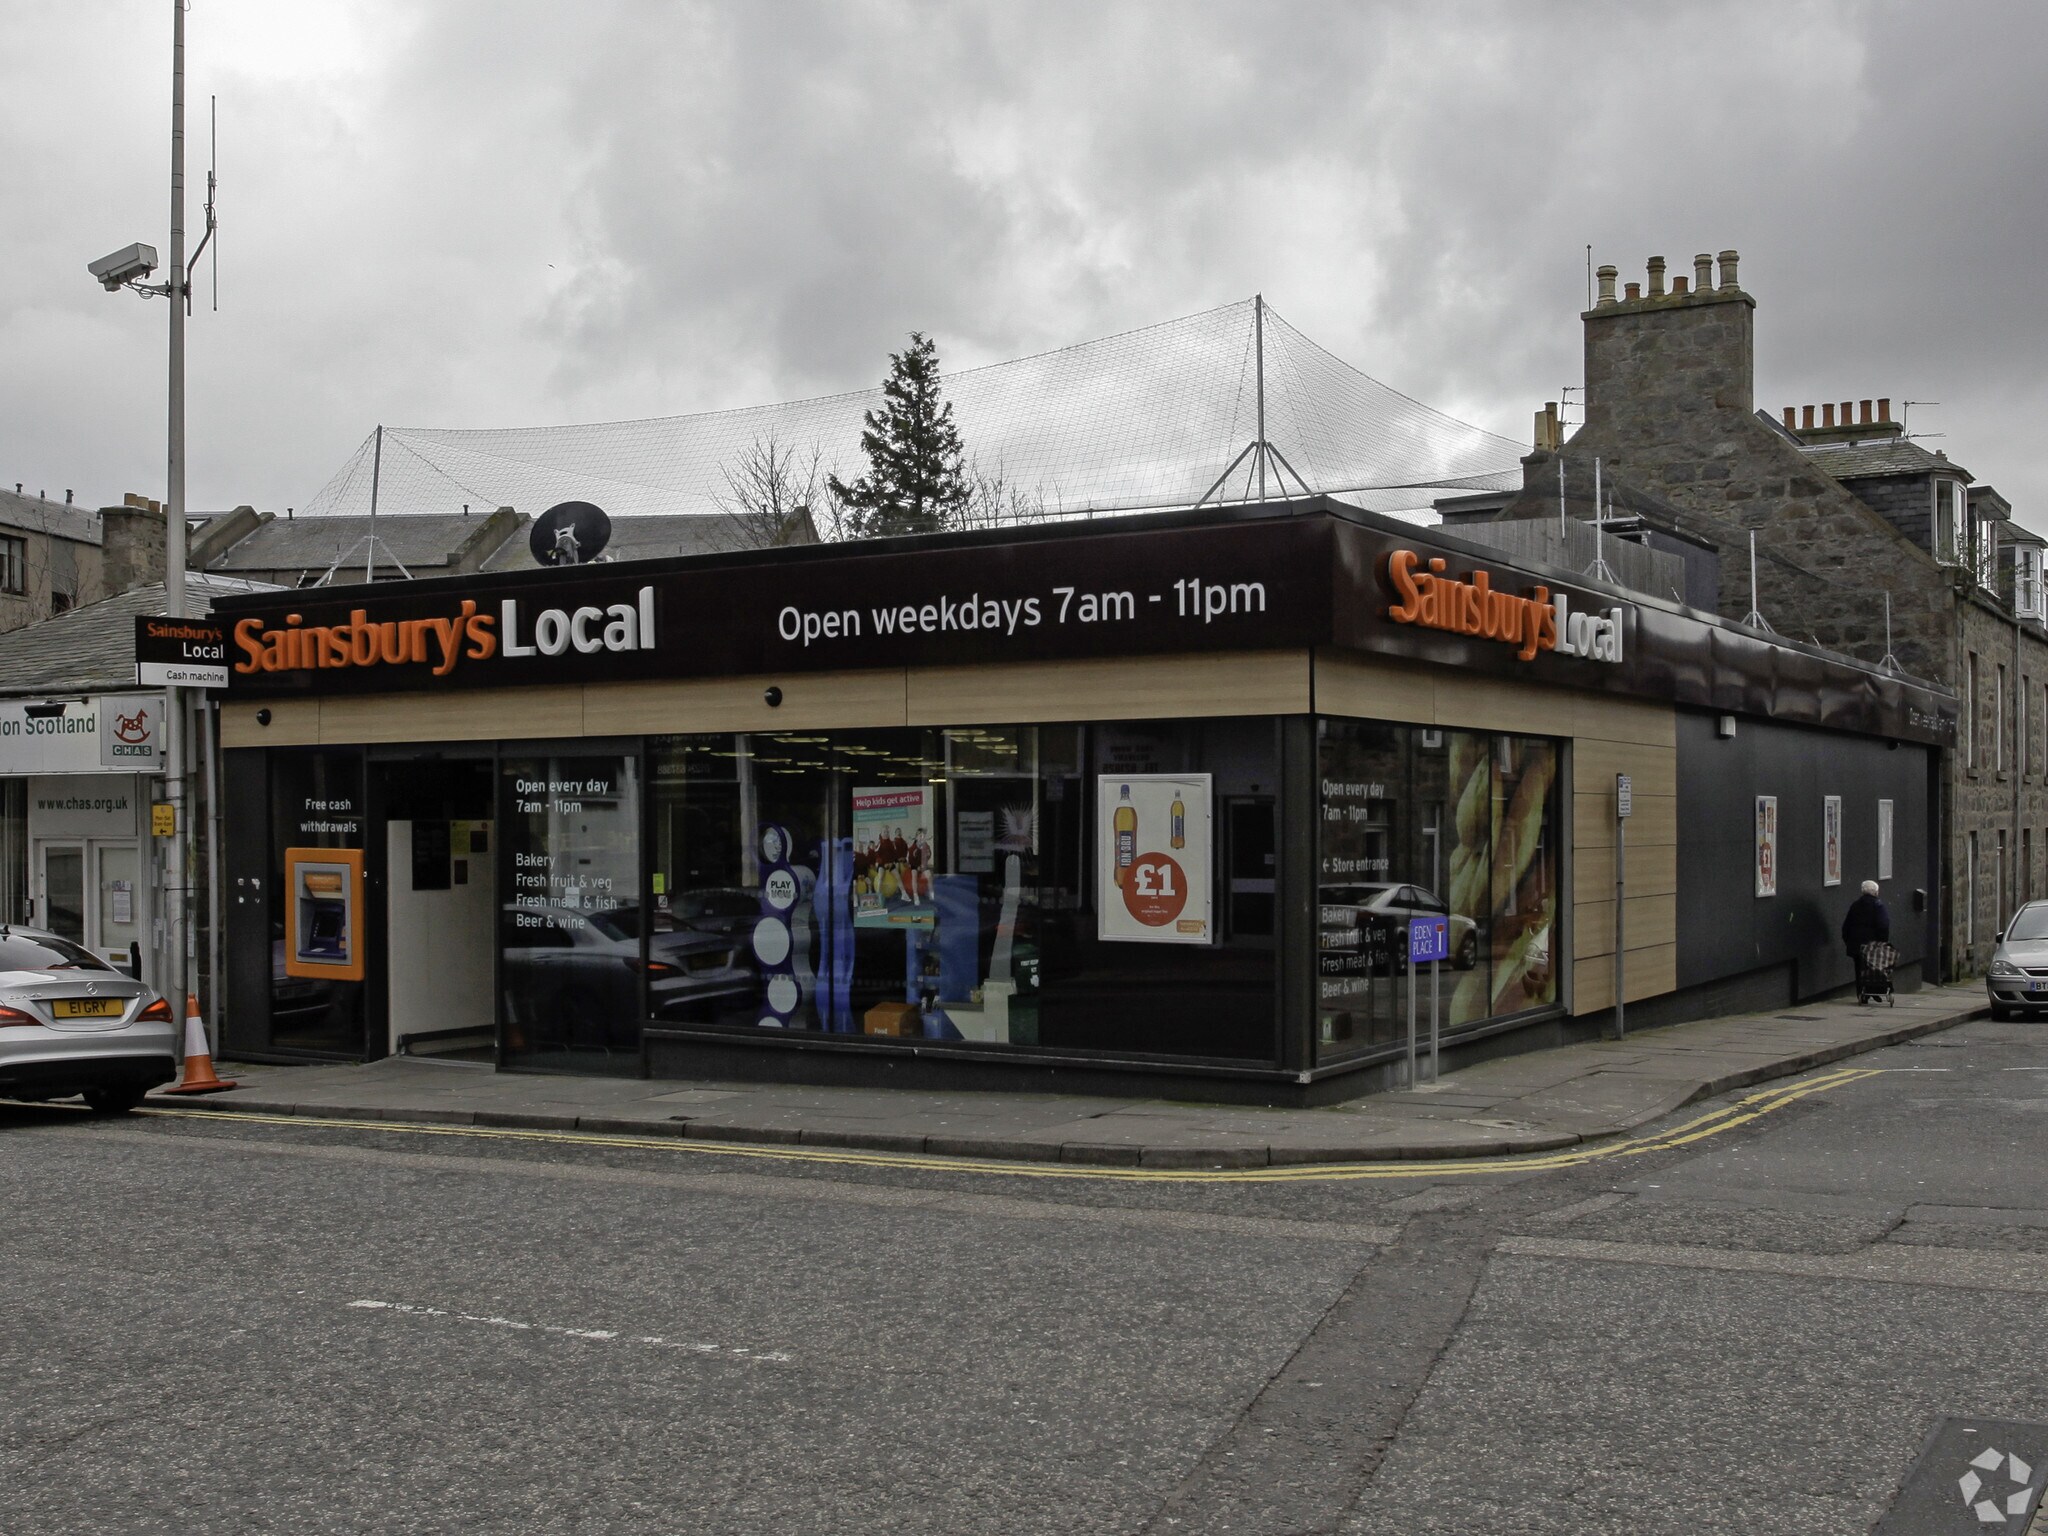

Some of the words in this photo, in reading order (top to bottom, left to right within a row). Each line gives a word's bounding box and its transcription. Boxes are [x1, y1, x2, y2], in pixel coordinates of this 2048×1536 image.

[778, 606, 861, 647] Open
[872, 593, 1041, 636] weekdays
[1052, 587, 1135, 624] 7am
[1148, 595, 1161, 603] -
[1173, 578, 1266, 623] 11pm
[1389, 549, 1557, 661] Sainsbury's
[1554, 593, 1623, 663] Local
[147, 622, 223, 643] Sainsbury's
[234, 599, 495, 676] Sainsbury's
[502, 586, 656, 657] Local
[183, 641, 224, 659] Local
[166, 669, 188, 681] Cash
[189, 670, 225, 682] machine
[25, 712, 96, 736] Scotland
[113, 745, 152, 756] CHAS
[516, 778, 546, 793] Open
[550, 780, 583, 795] every
[586, 778, 609, 794] day
[1322, 778, 1344, 798] Open
[1345, 783, 1369, 799] every
[1369, 781, 1385, 799] day
[38, 797, 128, 813] www.chas.org.uk
[305, 798, 327, 810] Free
[329, 799, 351, 810] cash
[516, 799, 542, 813] 7am
[555, 800, 582, 815] 11pm
[856, 799, 872, 807] Help
[872, 797, 886, 806] kids
[887, 796, 898, 806] get
[899, 794, 920, 802] active
[1322, 804, 1341, 820] 7am
[1348, 804, 1368, 823] 11pm
[300, 821, 357, 833] withdrawals
[516, 853, 556, 869] Bakery
[1332, 857, 1355, 873] Store
[1355, 856, 1389, 872] entrance
[516, 873, 547, 887] Fresh
[550, 874, 576, 888] fruit
[579, 875, 588, 889] &
[591, 877, 613, 892] veg
[770, 880, 791, 889] PLAY
[1134, 864, 1176, 896] £1
[516, 893, 547, 908] Fresh
[550, 896, 580, 909] me
[583, 895, 593, 909] &
[596, 896, 618, 910] fish
[516, 914, 543, 928] Beer
[546, 915, 555, 929] &
[558, 915, 586, 929] wine
[1322, 907, 1351, 923] Bakery
[1322, 931, 1345, 948] Fresh
[1364, 927, 1371, 942] &
[1372, 929, 1387, 943] veg
[1414, 924, 1432, 940] EDEN
[1412, 940, 1433, 955] PLACE
[1322, 956, 1345, 973] Fresh
[1345, 954, 1366, 969] meat
[1367, 950, 1373, 966] &
[1322, 981, 1342, 999] Beer
[1343, 979, 1349, 994] &
[1351, 978, 1369, 993] wine
[84, 1001, 107, 1013] GRY
